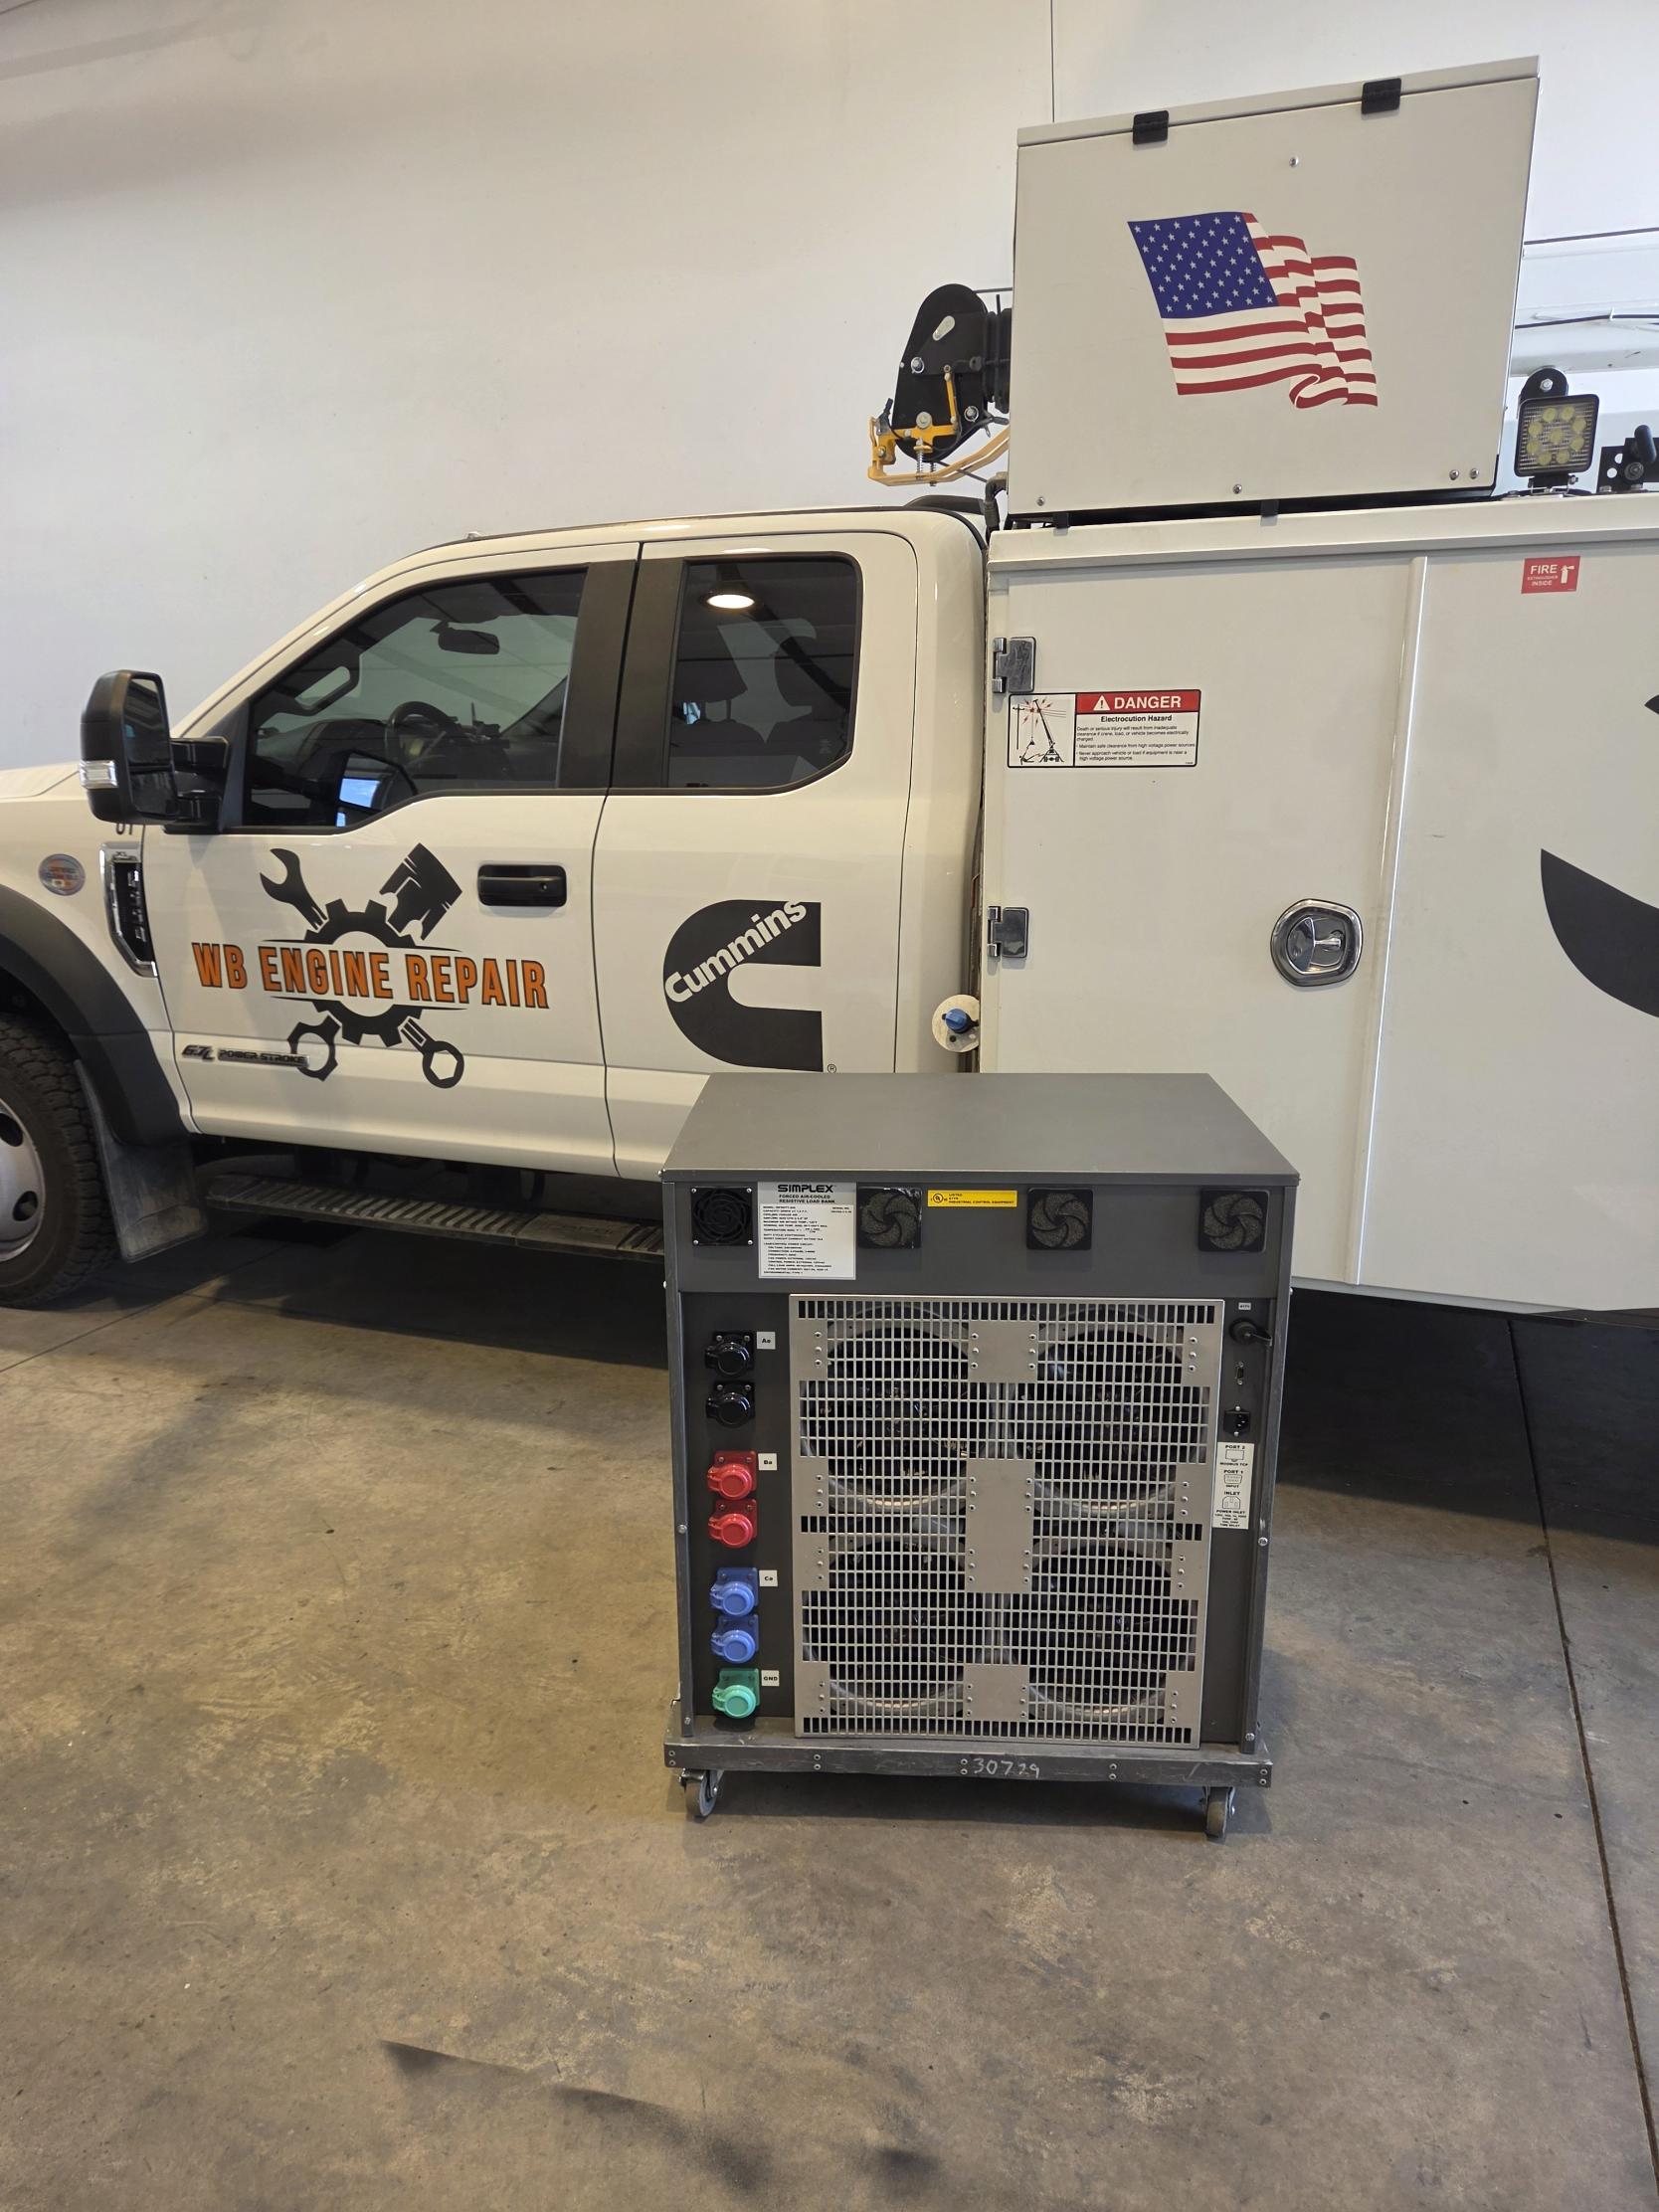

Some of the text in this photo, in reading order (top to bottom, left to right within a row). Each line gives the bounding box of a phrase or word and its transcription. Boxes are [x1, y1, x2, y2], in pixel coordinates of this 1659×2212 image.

[1530, 564, 1558, 574] FIRE
[1114, 695, 1182, 709] DANGER
[664, 901, 807, 1003] Cummins
[191, 942, 550, 1010] WB ENGINE REPAIR
[259, 1052, 307, 1063] STROKE
[777, 1184, 833, 1194] SIMPLEX
[974, 1757, 1040, 1779] 30729
